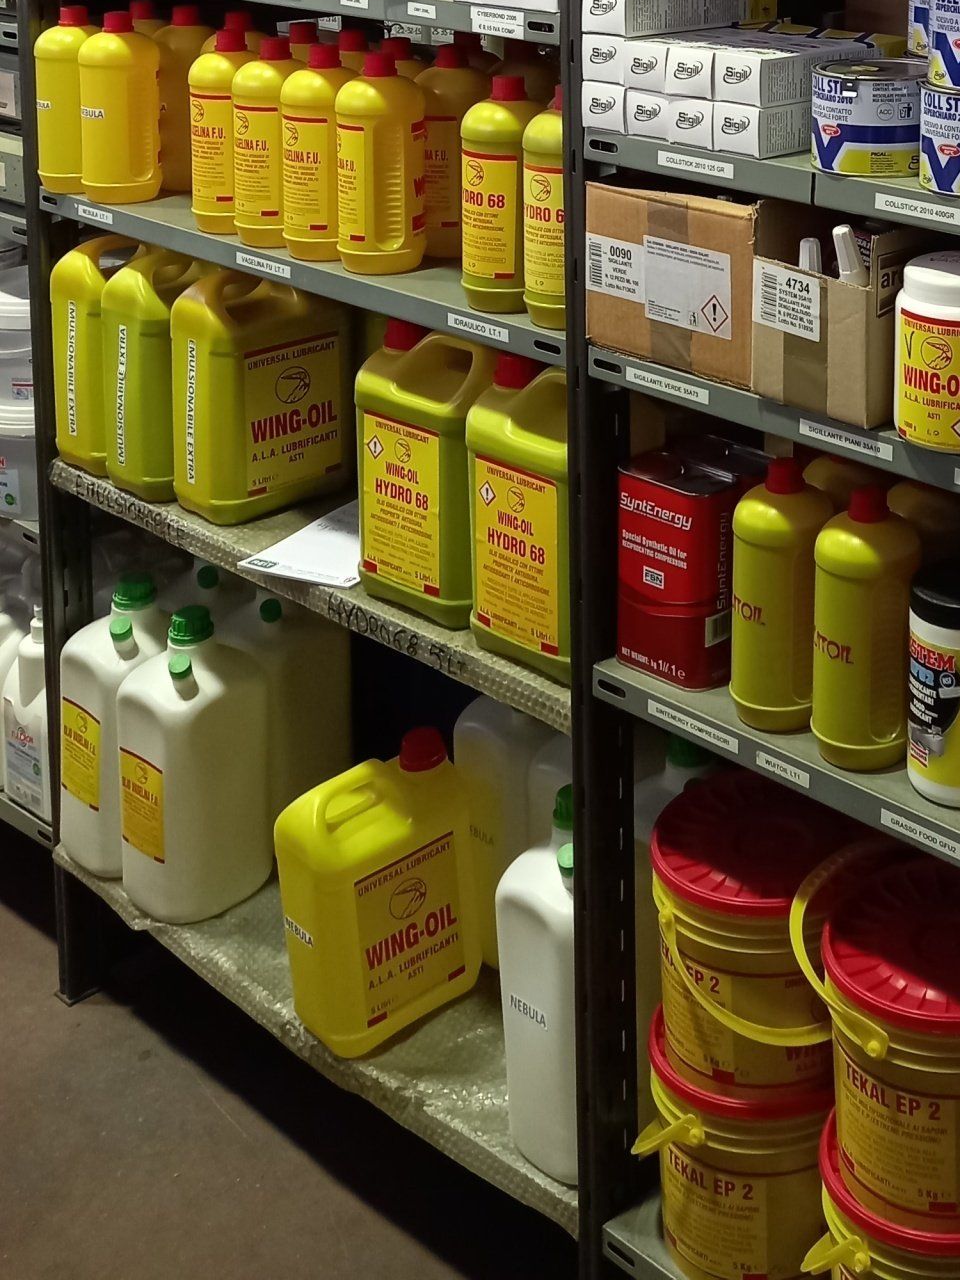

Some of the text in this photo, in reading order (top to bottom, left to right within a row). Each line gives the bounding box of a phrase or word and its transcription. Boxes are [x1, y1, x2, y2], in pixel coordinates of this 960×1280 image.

[923, 95, 944, 113] COLL
[884, 199, 954, 219] COLLSTICK 2010 400GR
[785, 277, 810, 295] 4734
[453, 317, 501, 337] IDRAULICO LT.1
[187, 340, 196, 481] EMULSIONABILE EXTRA
[385, 461, 420, 485] WING-OIL
[375, 478, 429, 511] HYDRO 68
[620, 492, 692, 531] SyntEnergy
[510, 994, 547, 1029] NEBULA
[845, 1060, 941, 1121] TEKAL EP 2
